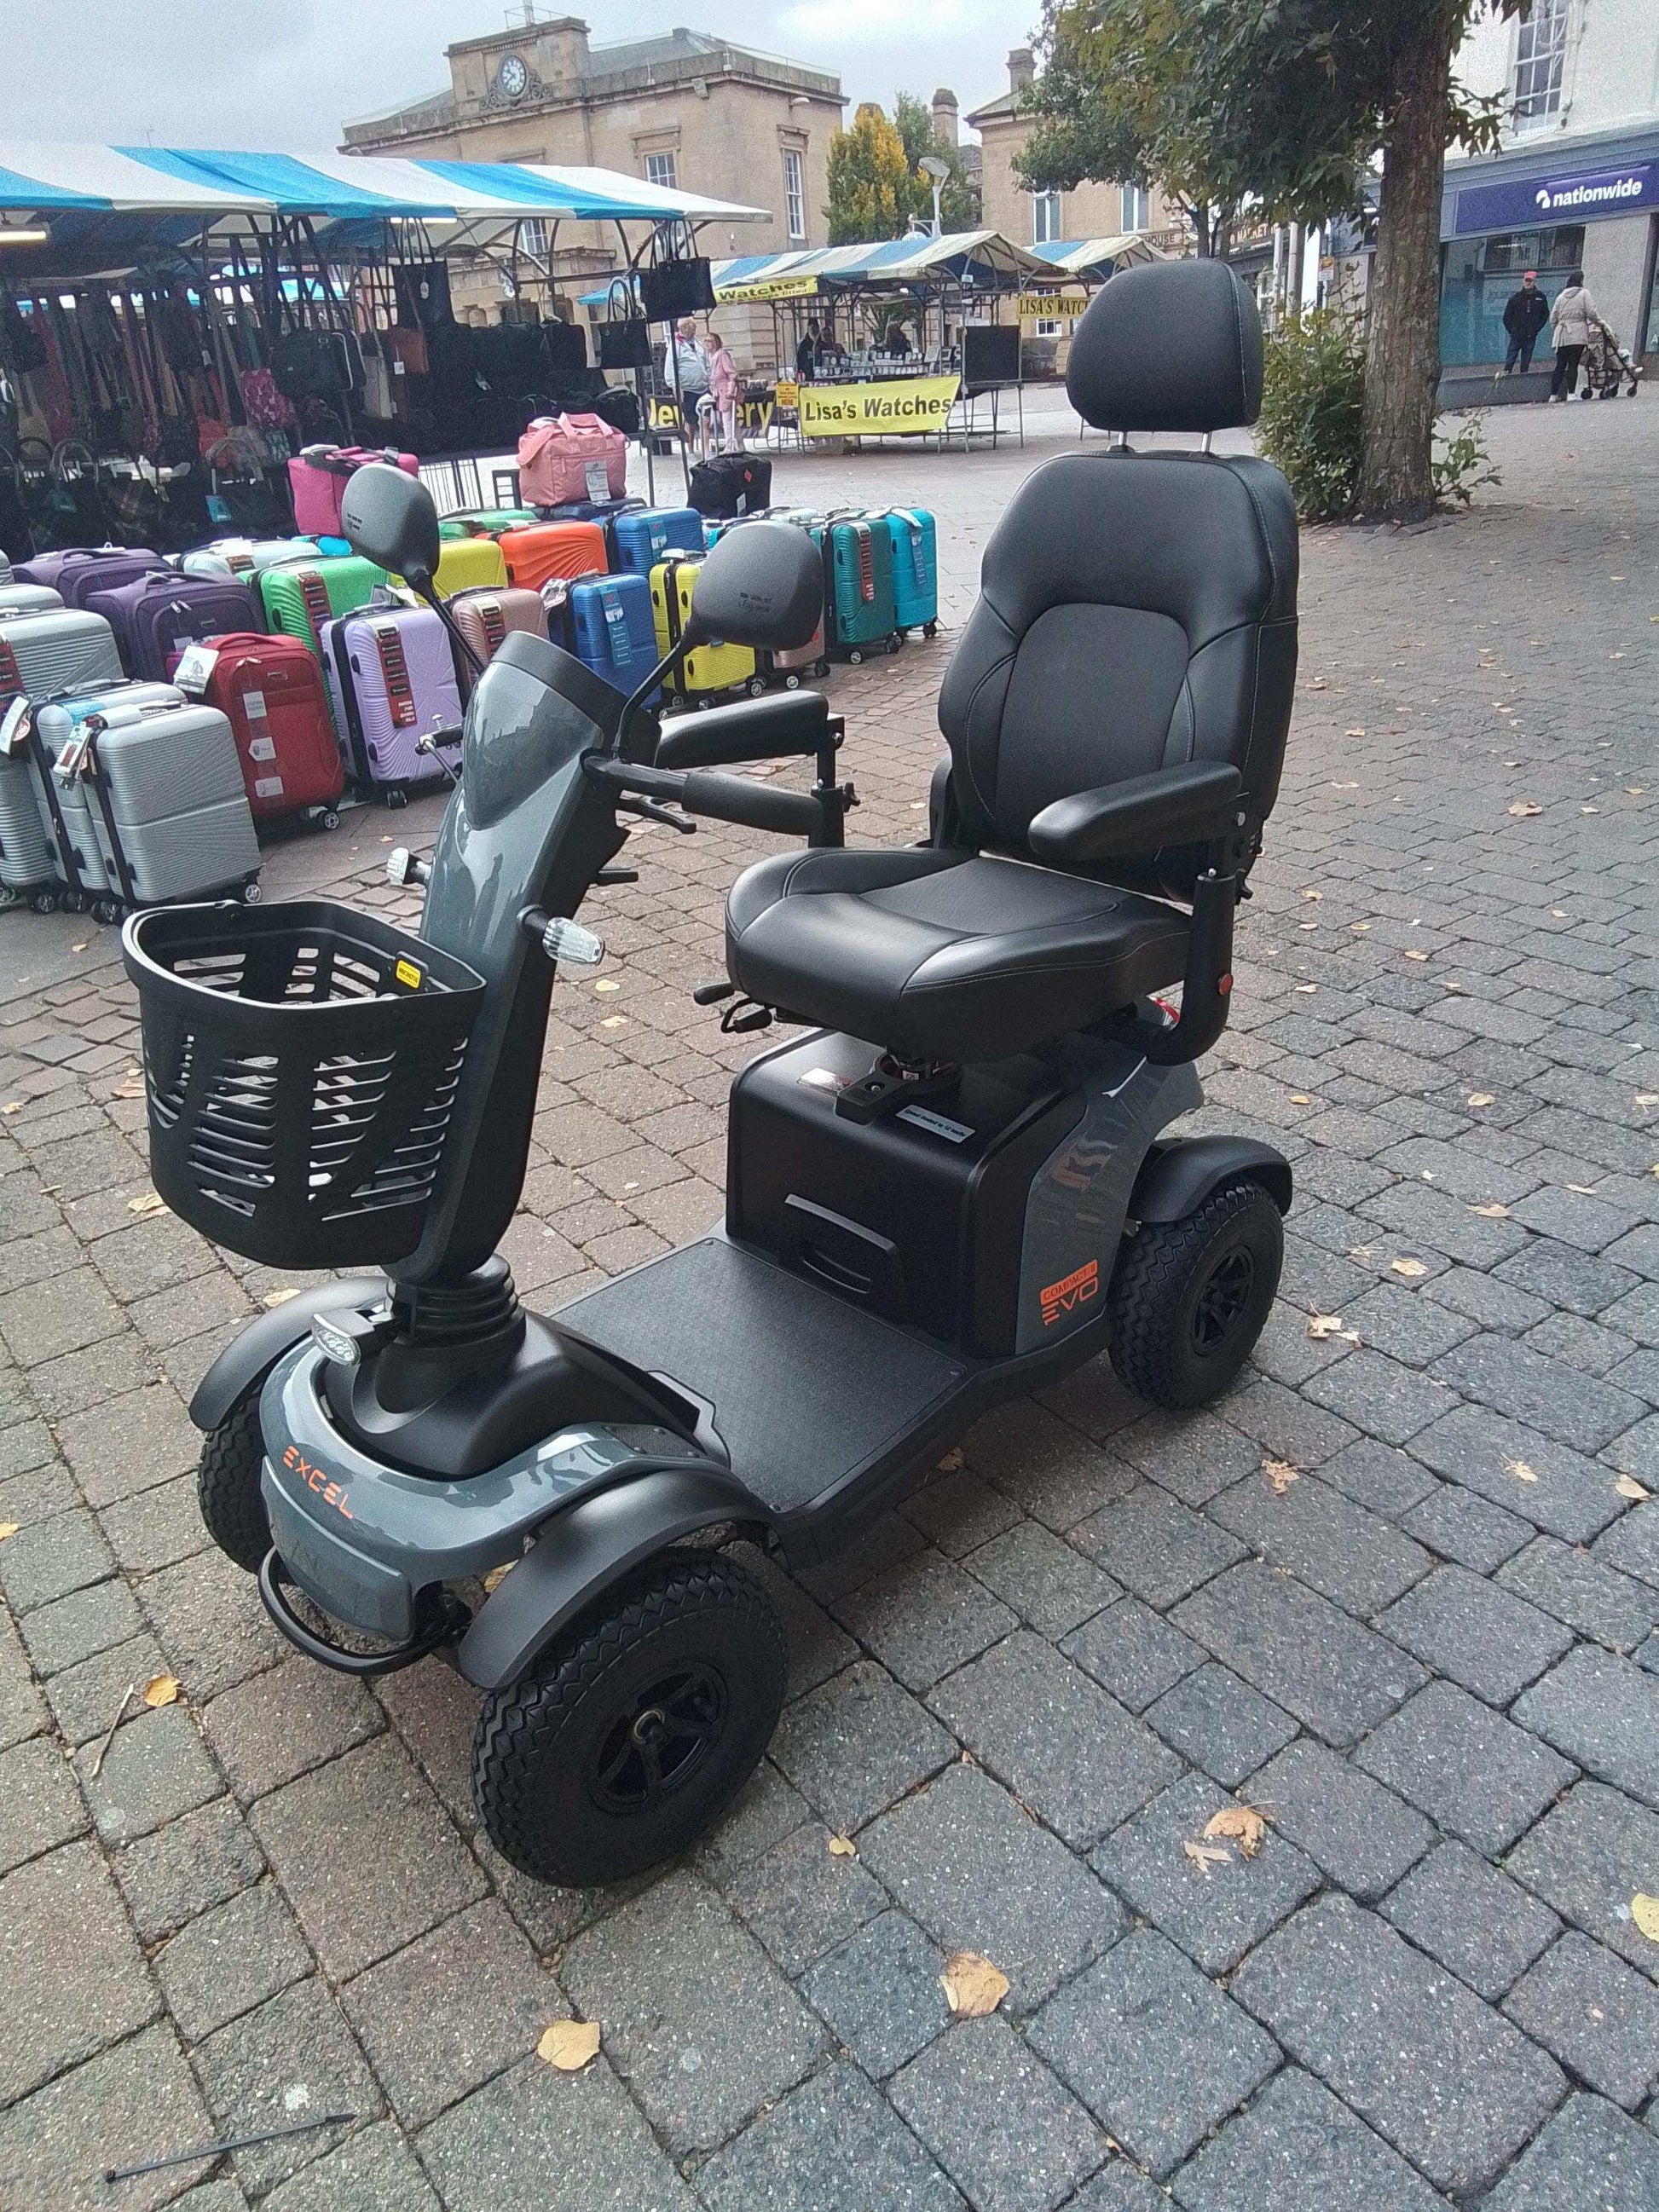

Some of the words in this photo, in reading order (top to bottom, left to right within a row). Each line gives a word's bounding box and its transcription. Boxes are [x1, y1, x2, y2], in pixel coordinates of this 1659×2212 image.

[1553, 178, 1642, 206] nationwide
[719, 280, 807, 300] Watches
[1020, 298, 1053, 315] LISA'S
[805, 400, 857, 421] Lisa's
[864, 395, 952, 419] Watches
[1042, 1277, 1098, 1326] EVO
[283, 1445, 354, 1519] EXCEL
